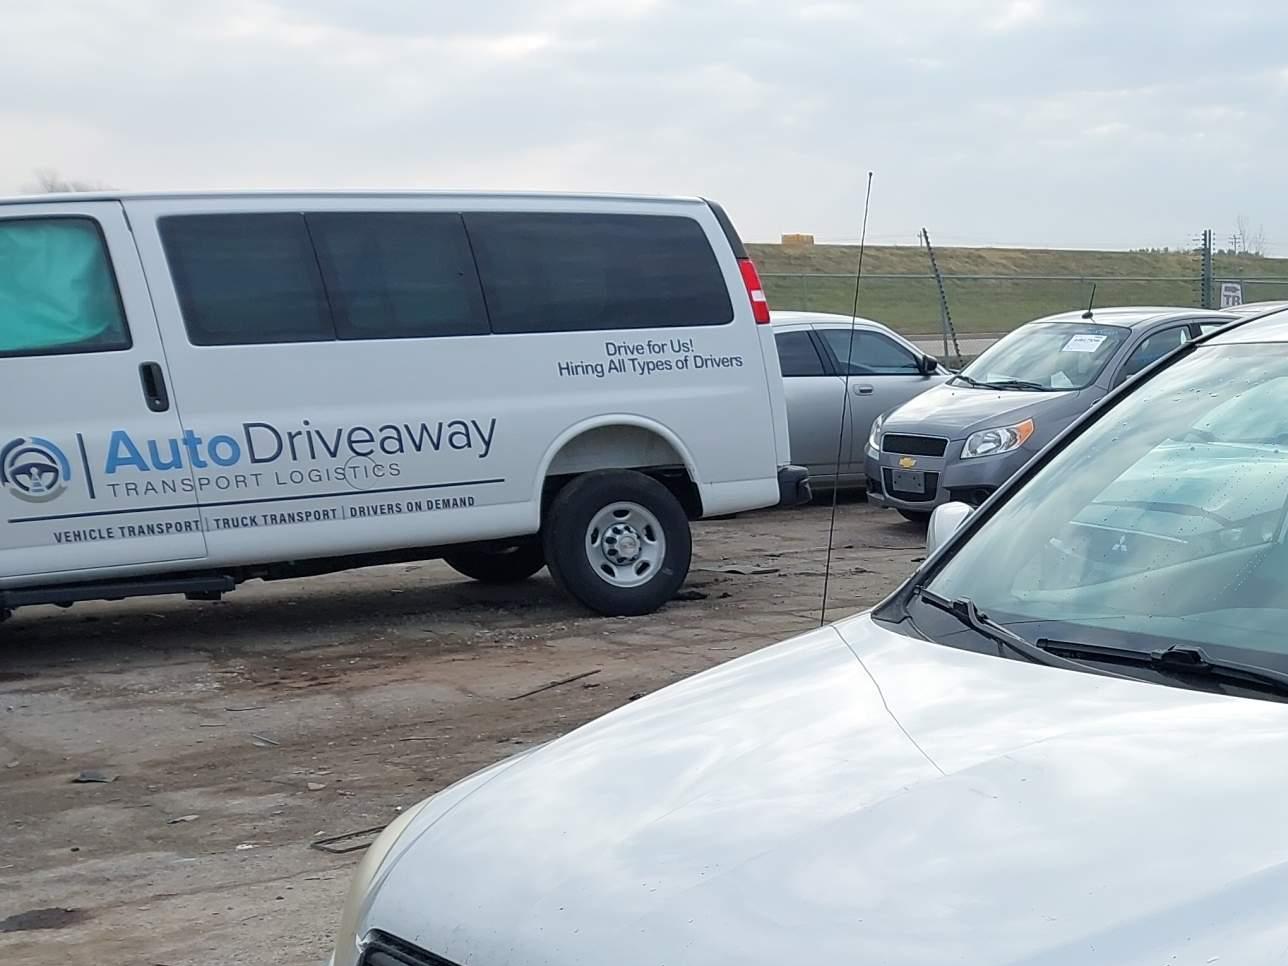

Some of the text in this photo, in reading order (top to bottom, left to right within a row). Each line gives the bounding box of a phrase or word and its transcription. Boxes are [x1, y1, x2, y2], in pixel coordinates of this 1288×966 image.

[605, 339, 694, 356] Drive for Us!
[558, 354, 743, 377] Hiring All Types of Drivers
[104, 418, 497, 473] AutoDriveaway
[107, 463, 401, 498] TRANSPORT LOGISTICS
[53, 496, 476, 544] VEHICLE TRANSPORT TRUCK TRANSPORT DRIVERS ON DEMAND
